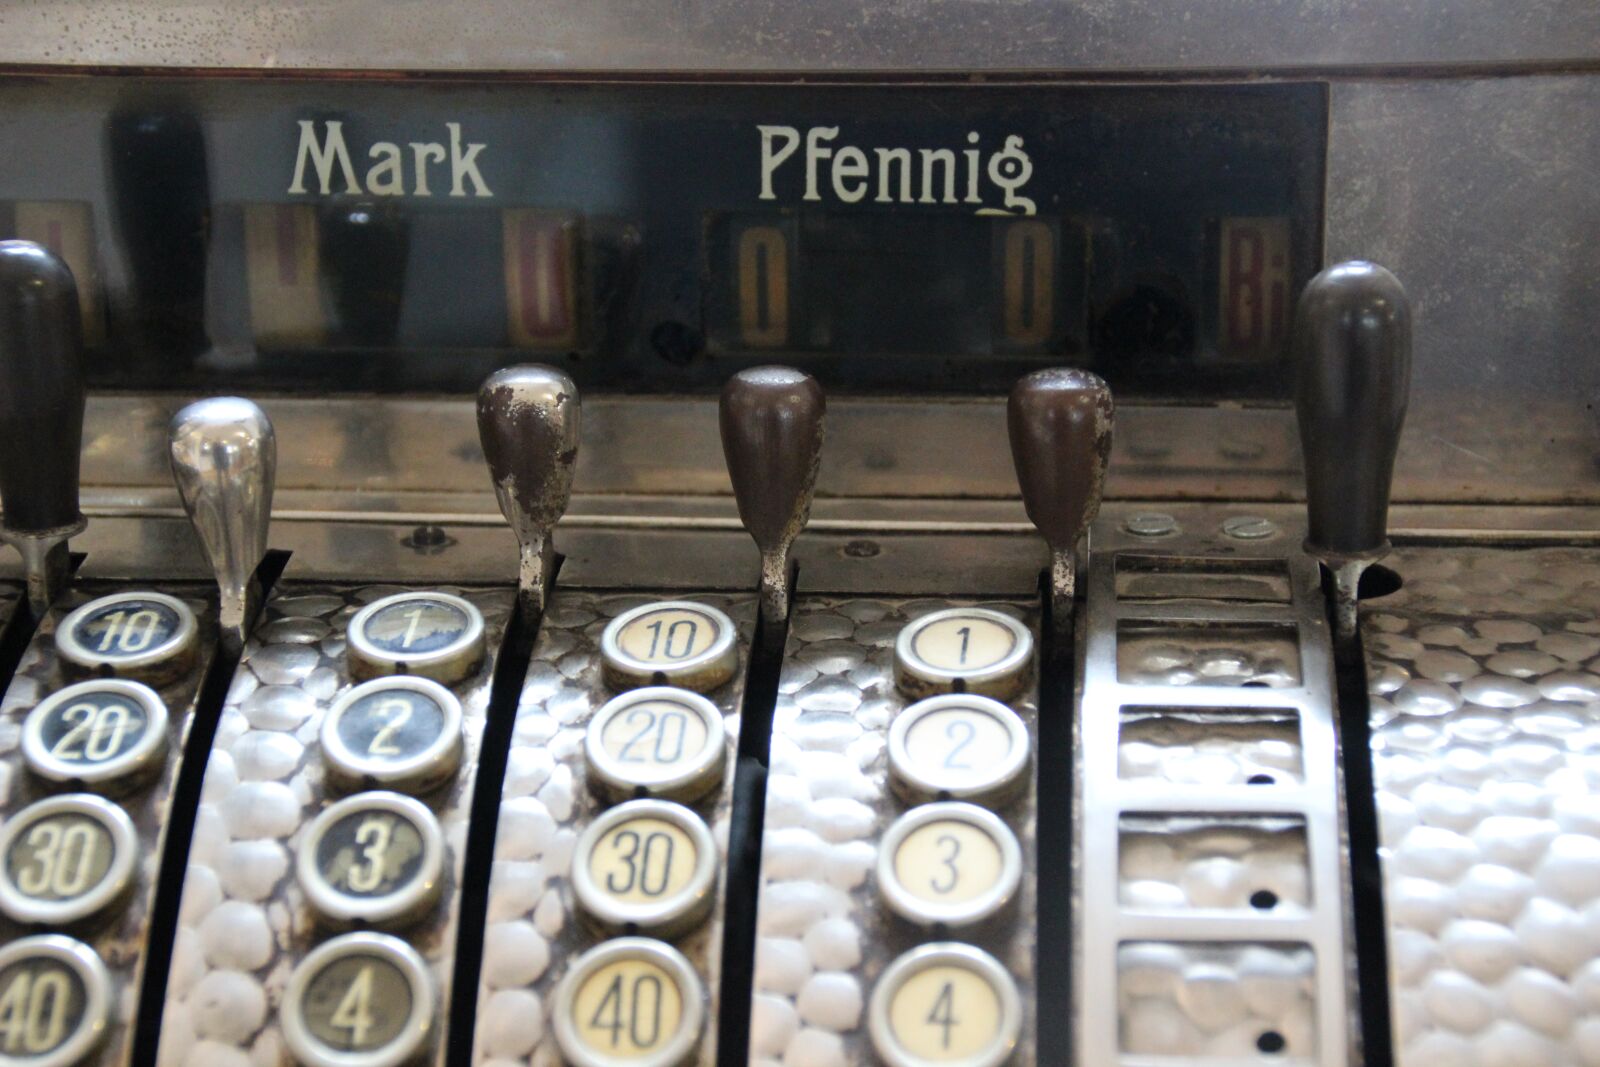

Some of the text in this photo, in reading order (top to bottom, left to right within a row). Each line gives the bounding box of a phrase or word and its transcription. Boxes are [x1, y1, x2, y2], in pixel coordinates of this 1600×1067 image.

[288, 121, 493, 197] Mark
[757, 125, 1037, 216] Pfennig
[739, 227, 788, 345] 0
[1005, 220, 1054, 344] 0
[97, 610, 159, 652] 10
[400, 609, 424, 648] 1
[645, 620, 697, 660] 10
[956, 626, 971, 664] 1
[53, 703, 129, 761] 20
[368, 698, 412, 756] 2
[618, 709, 688, 764] 20
[943, 719, 978, 770] 2
[18, 822, 98, 896] 30
[348, 821, 389, 892] 3
[606, 831, 674, 897] 30
[930, 835, 961, 894] 3
[0, 970, 72, 1053] 40
[331, 966, 374, 1046] 4
[589, 974, 662, 1049] 40
[924, 981, 960, 1051] 4
